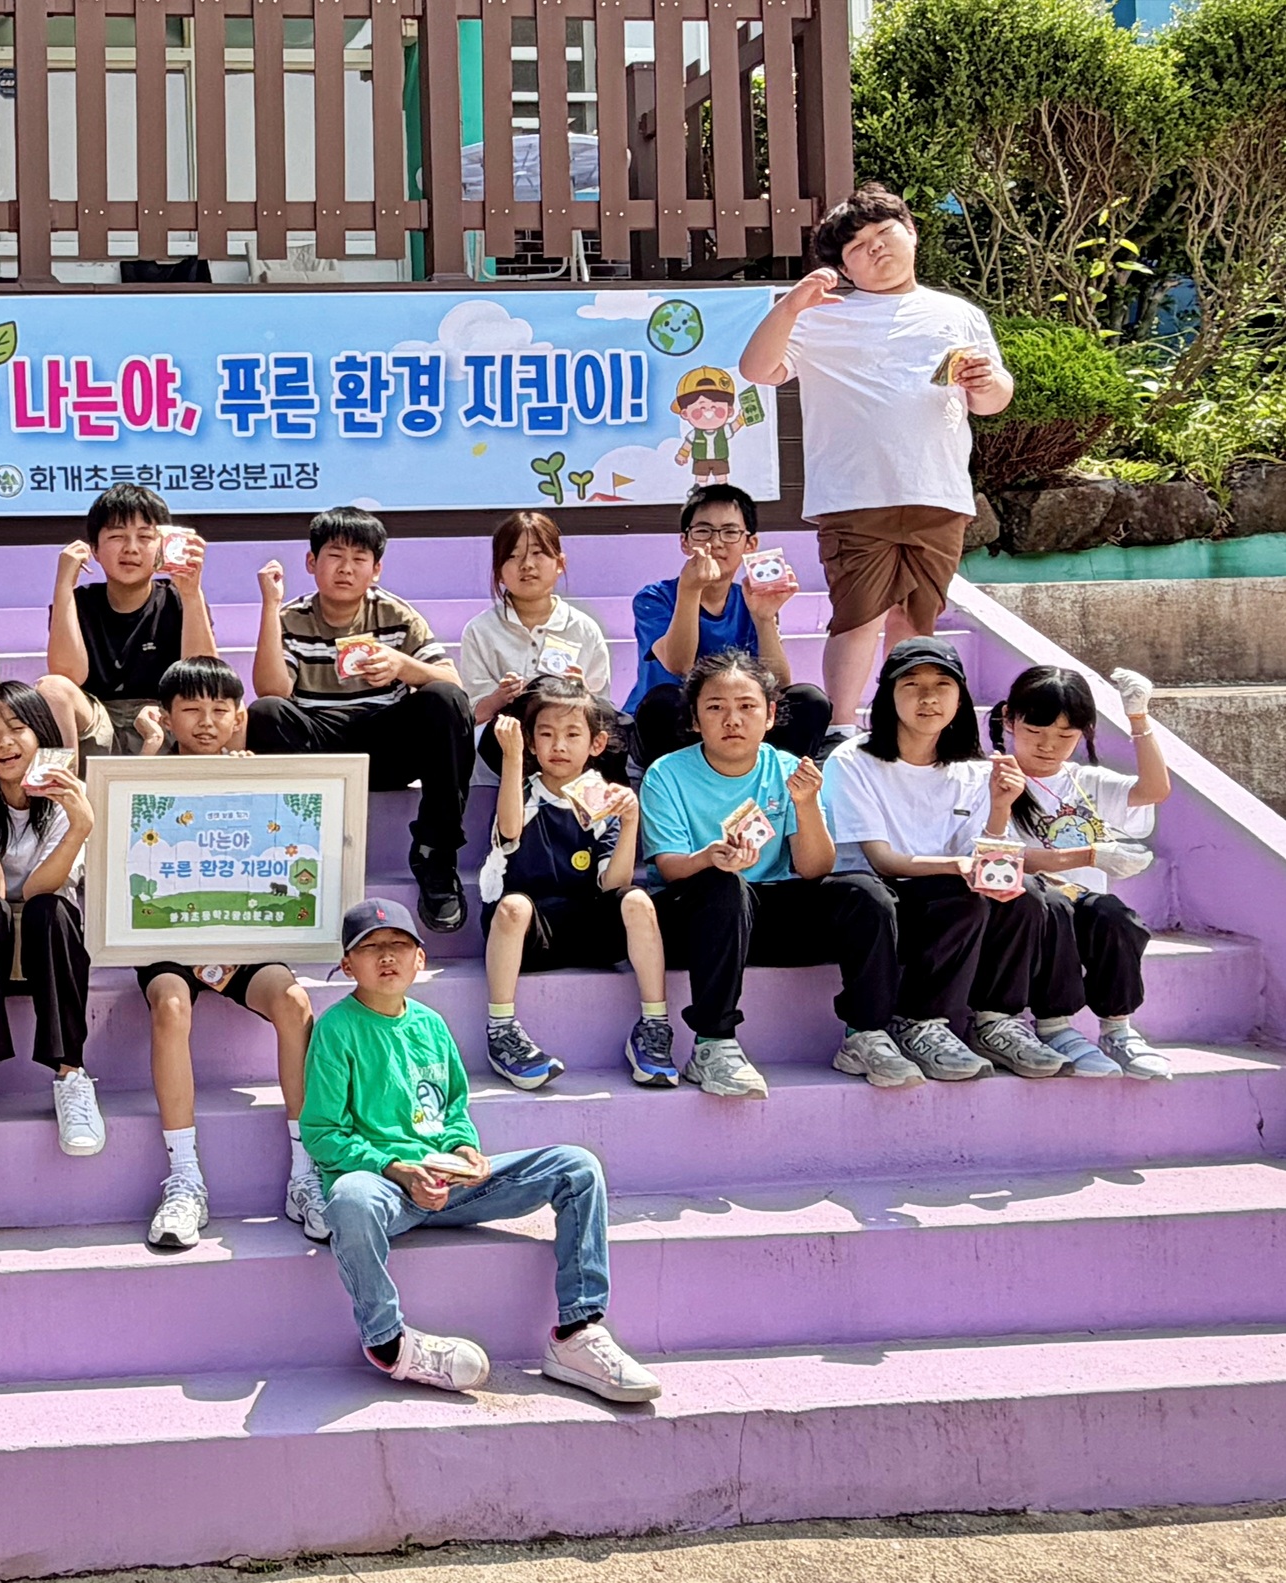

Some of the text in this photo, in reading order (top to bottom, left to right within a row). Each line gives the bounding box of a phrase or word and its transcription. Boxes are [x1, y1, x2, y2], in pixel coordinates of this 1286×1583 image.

[11, 357, 199, 437] 나는야,
[218, 355, 316, 435] 푸른
[333, 353, 447, 433] 환경
[462, 351, 644, 433] 지킴이!
[197, 831, 251, 849] 나는야
[158, 859, 289, 879] 푸른 환경 지킴이
